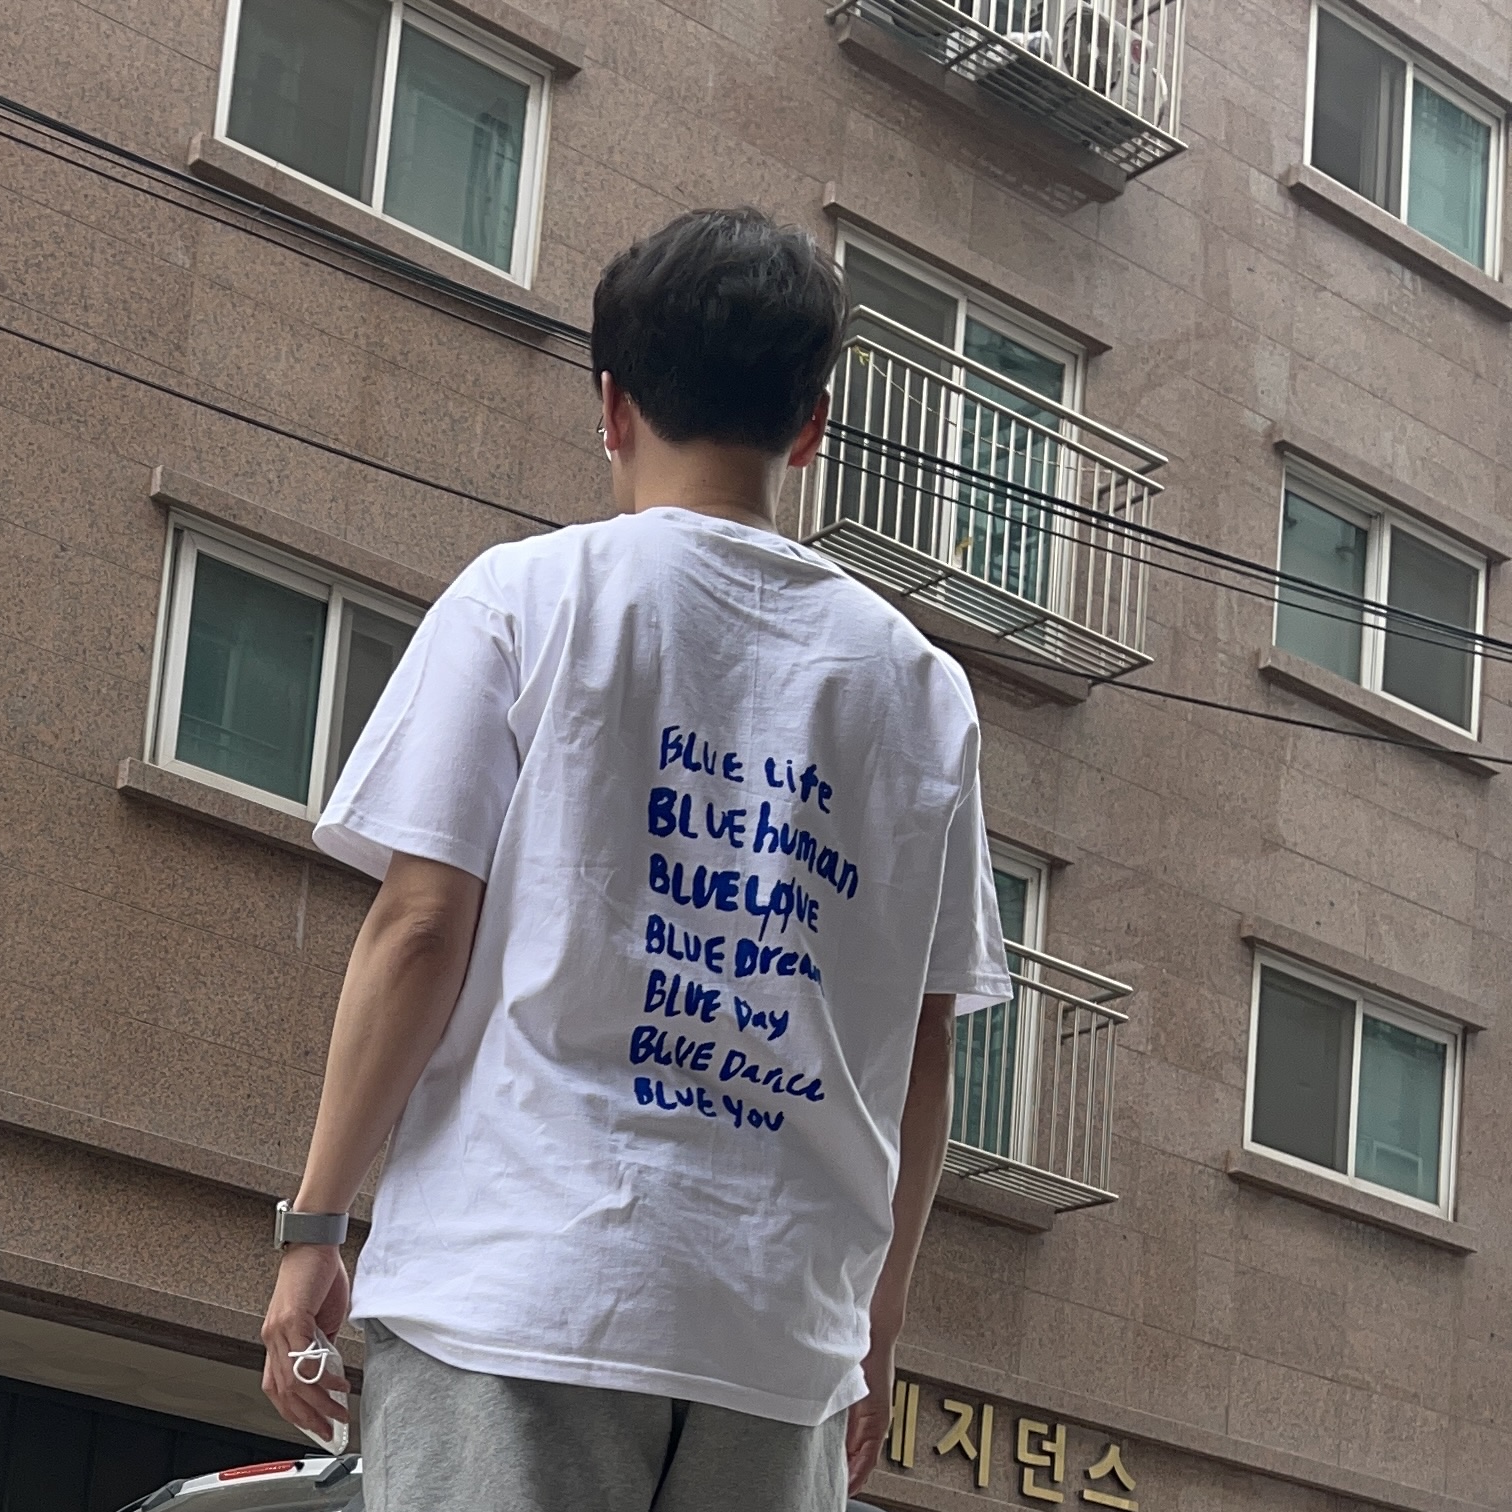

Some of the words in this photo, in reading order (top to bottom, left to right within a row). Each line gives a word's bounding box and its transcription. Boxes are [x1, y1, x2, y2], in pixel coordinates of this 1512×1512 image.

[660, 725, 744, 783] BLUE
[648, 787, 747, 848] BLUE
[753, 800, 859, 900] human
[649, 853, 740, 912] BLUE
[645, 914, 725, 974] BLUE
[644, 969, 721, 1023] BLUE
[734, 995, 790, 1042] Day
[629, 1025, 716, 1071] BLUE
[633, 1076, 717, 1118] BLUE
